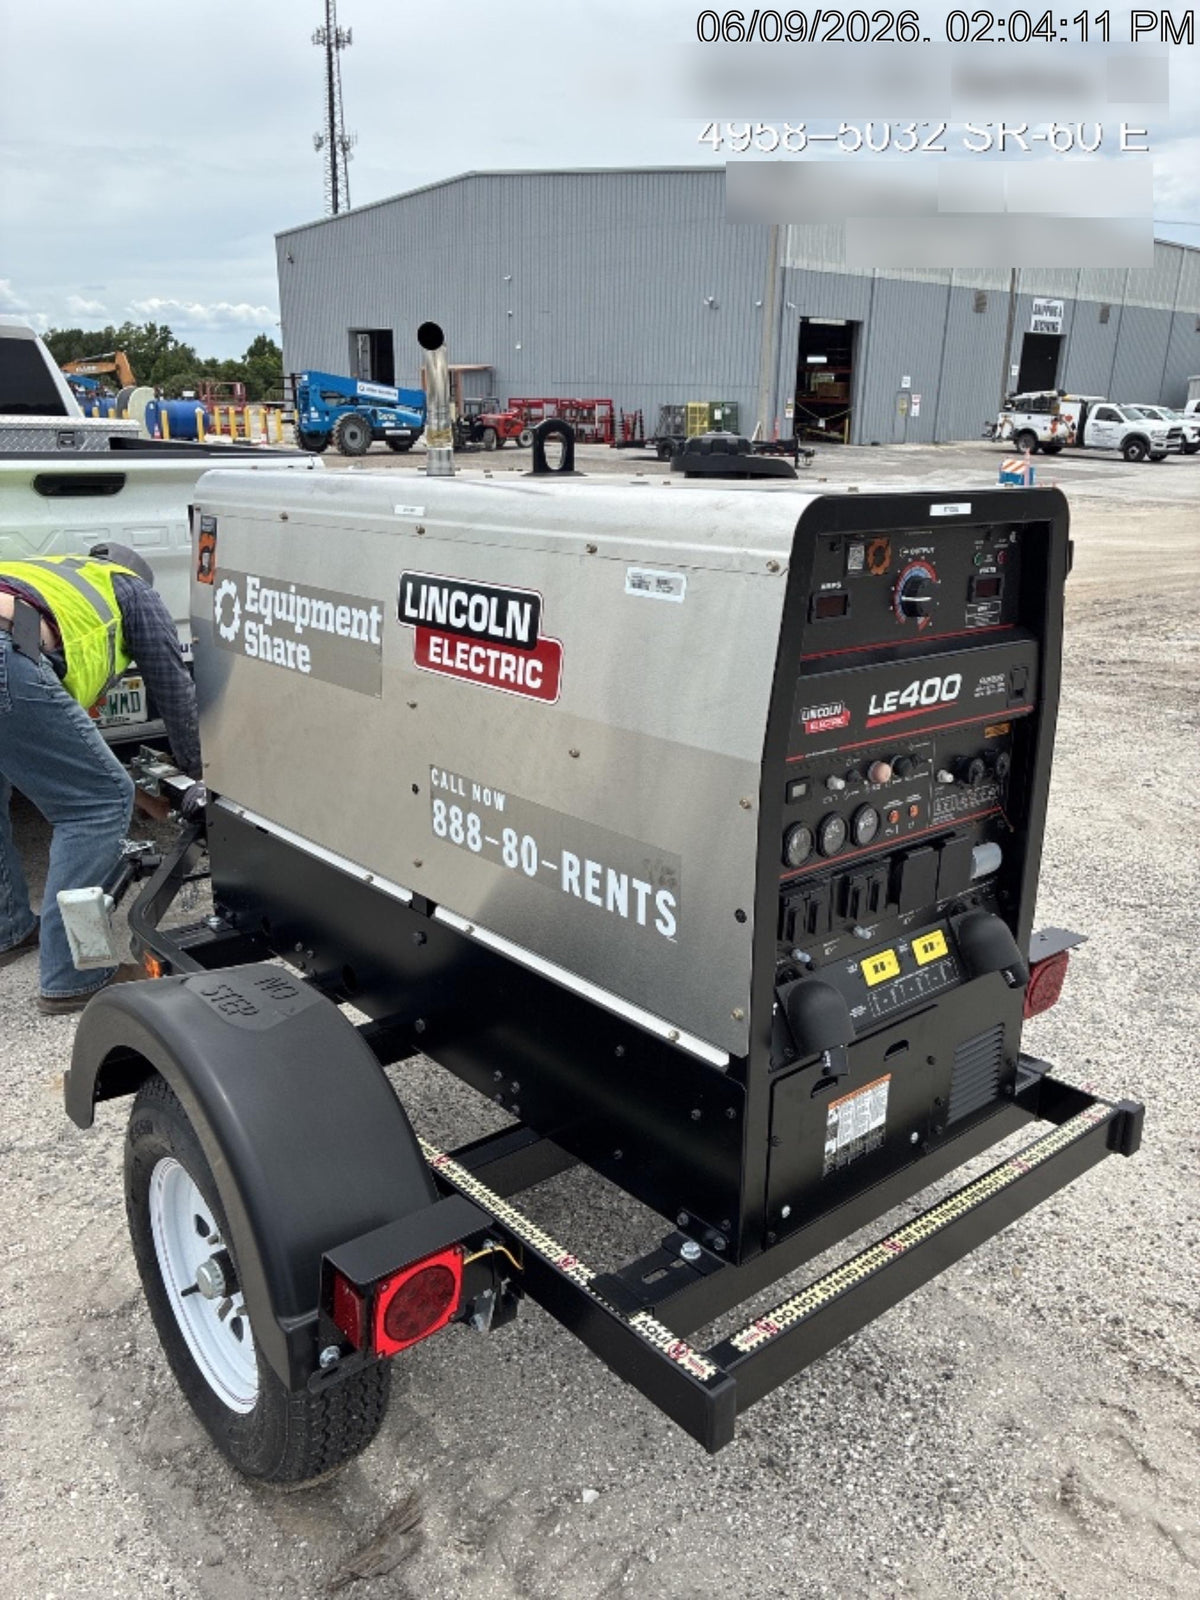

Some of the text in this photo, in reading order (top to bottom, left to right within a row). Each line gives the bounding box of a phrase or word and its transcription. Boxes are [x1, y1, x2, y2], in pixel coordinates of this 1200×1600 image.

[245, 576, 383, 645] Equipment
[404, 581, 532, 642] LINCOLN
[244, 625, 312, 675] Share
[428, 637, 543, 690] ELECTRIC
[867, 673, 963, 716] LE400
[431, 768, 505, 812] CALL NOW
[432, 798, 679, 939] 888-80-RENTS
[200, 984, 261, 1016] STEP
[252, 977, 299, 1000] NO
[773, 1247, 888, 1324] DO NOT STAND HERE
